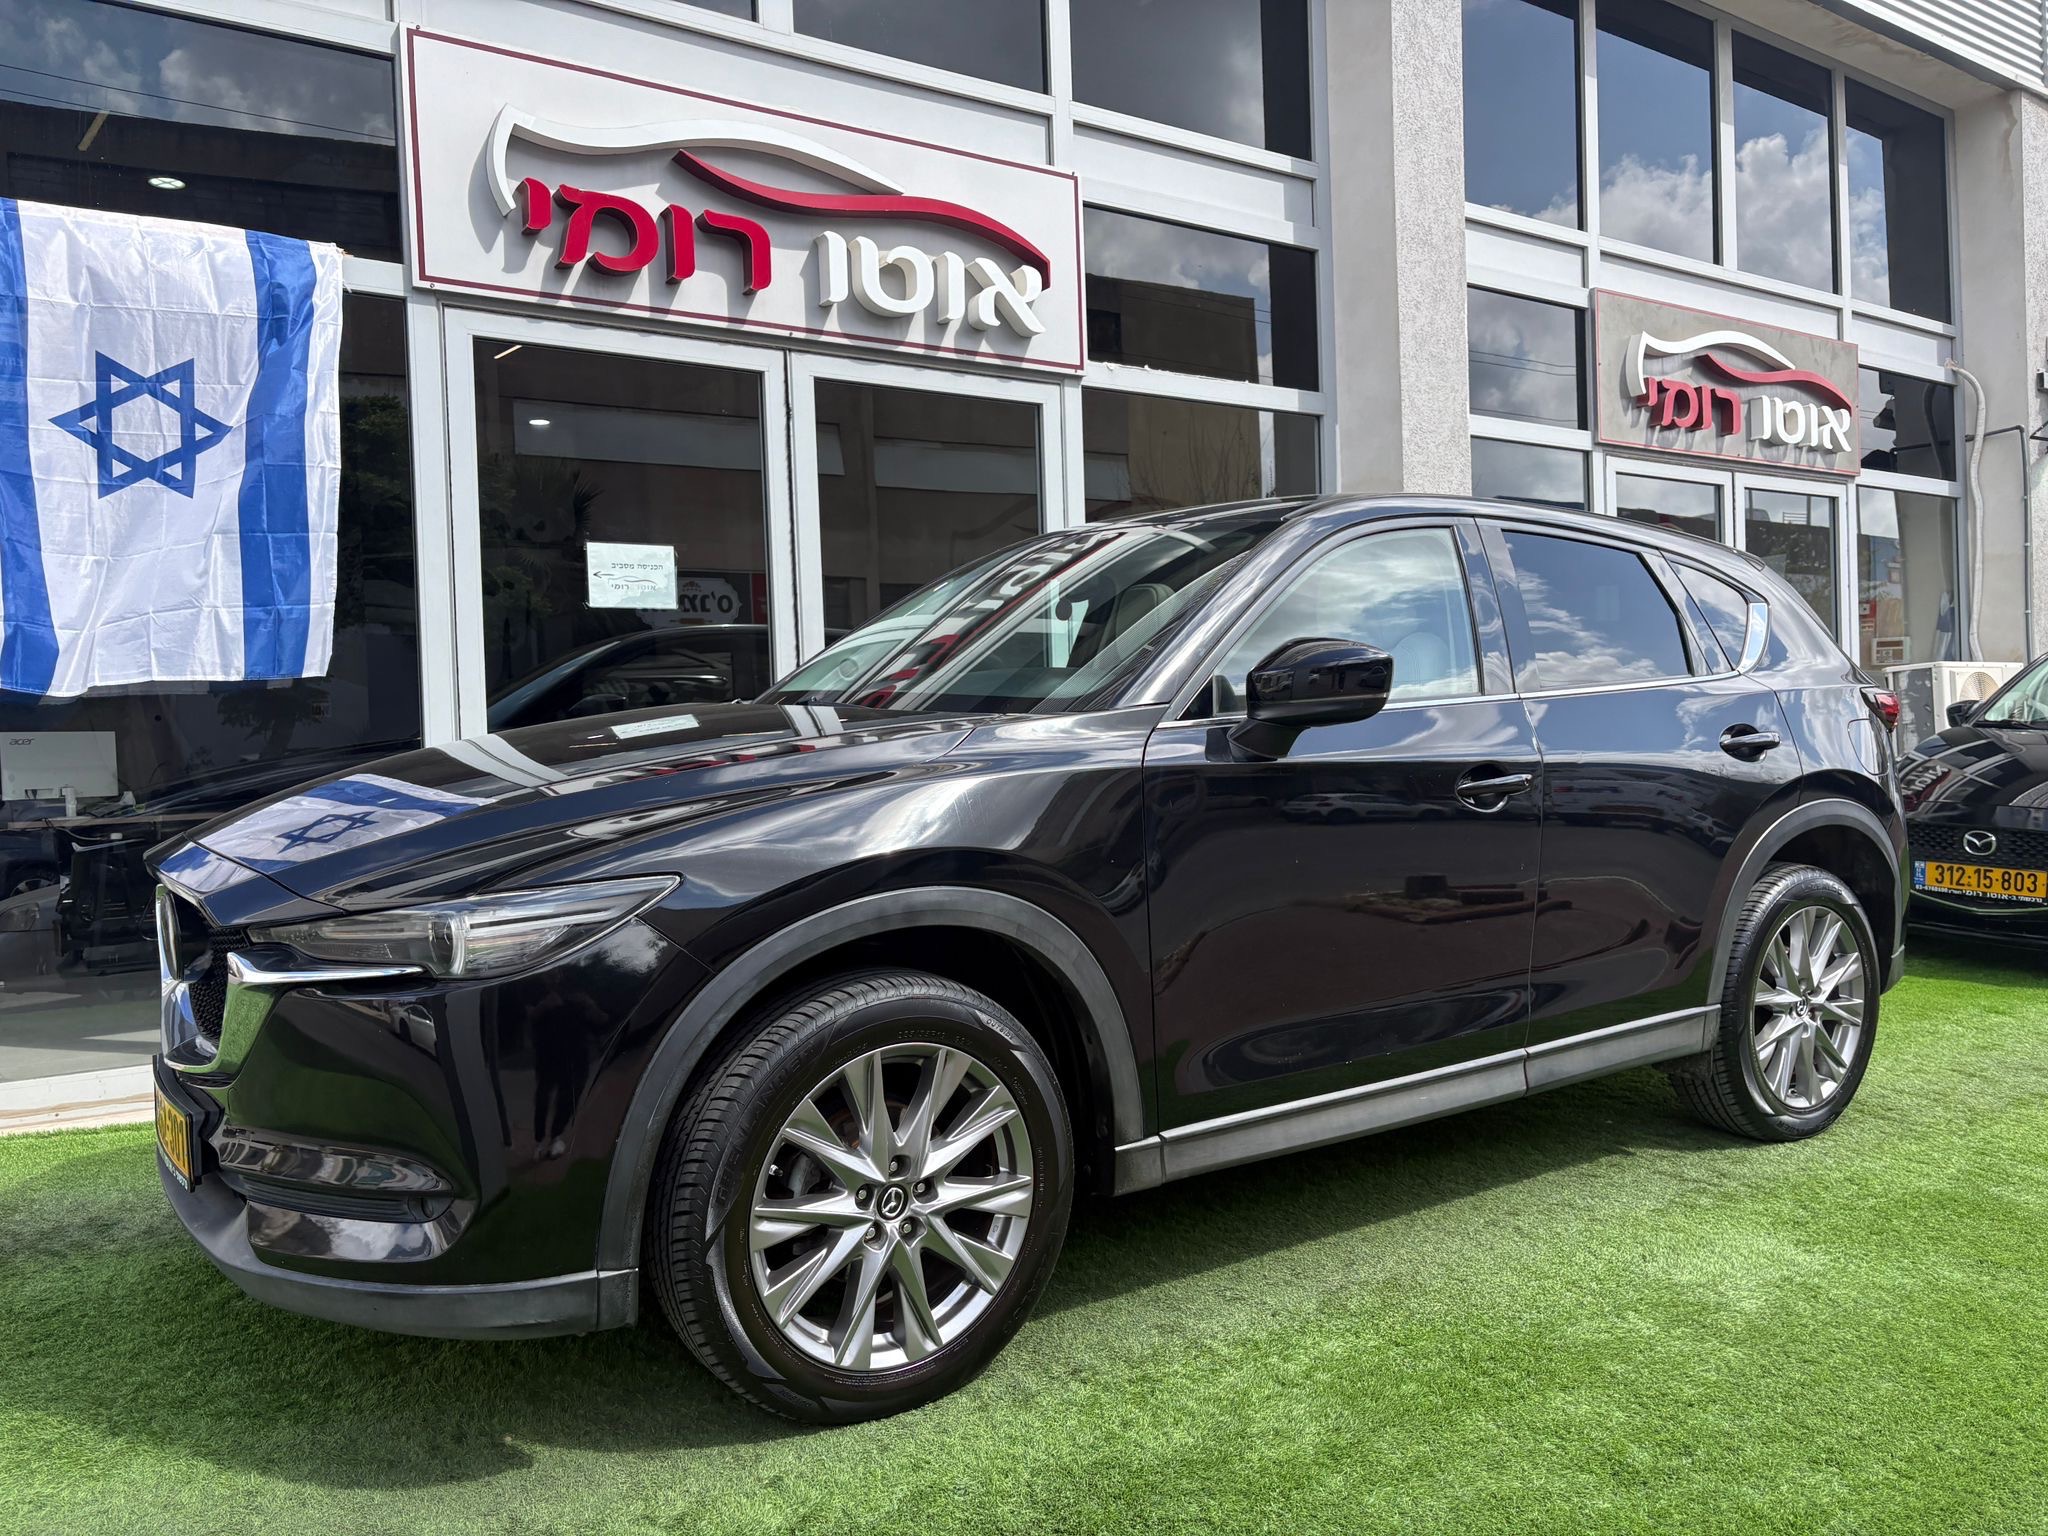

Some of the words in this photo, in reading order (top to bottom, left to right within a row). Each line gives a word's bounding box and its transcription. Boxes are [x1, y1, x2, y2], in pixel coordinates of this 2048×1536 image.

[514, 176, 771, 296] רומי
[813, 230, 1046, 338] אוטו
[1636, 377, 1741, 436] רומי
[1750, 395, 1852, 452] אוטו
[611, 562, 635, 570] מסביב
[9, 737, 35, 746] acer
